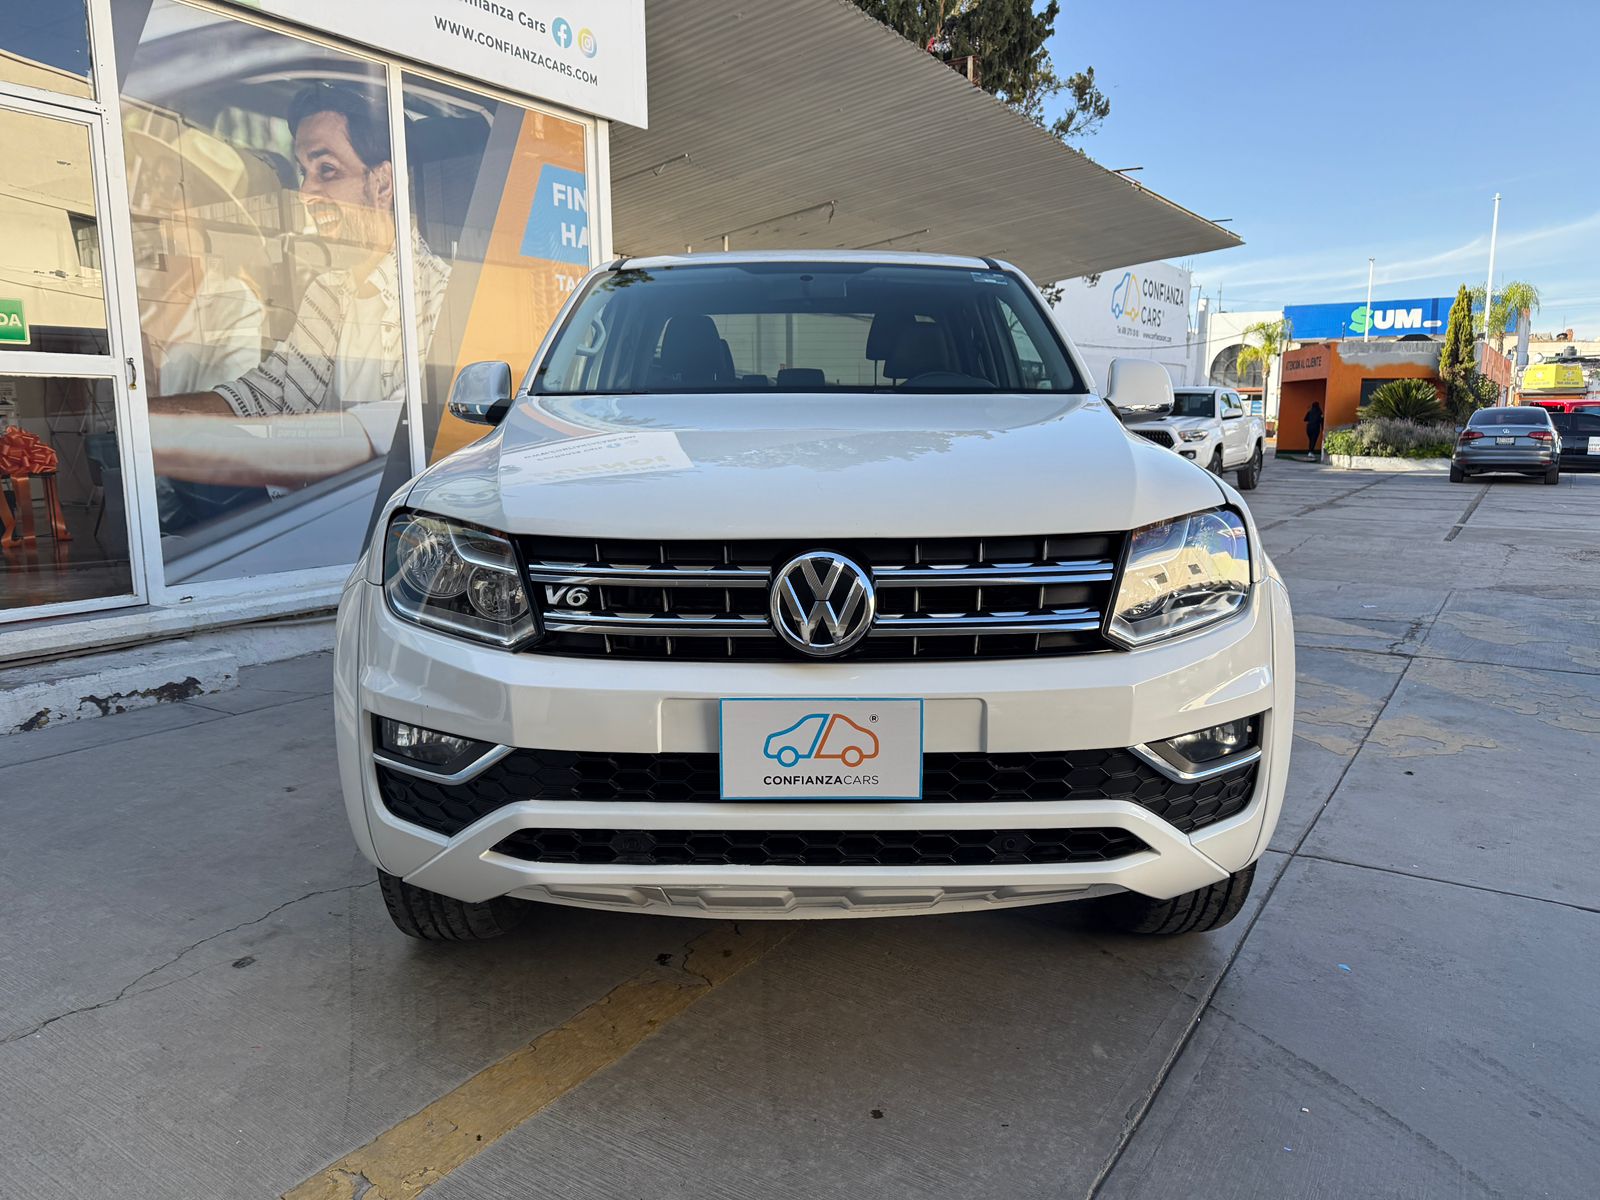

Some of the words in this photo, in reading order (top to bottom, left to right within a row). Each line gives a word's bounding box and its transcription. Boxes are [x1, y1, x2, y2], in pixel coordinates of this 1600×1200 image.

[518, 11, 546, 34] Cars
[434, 15, 598, 87] WWW.CONFIANZACARS.COM
[1142, 278, 1184, 308] CONFIANZA
[1141, 306, 1161, 328] CARS
[544, 584, 590, 607] V6
[763, 774, 879, 786] CONFIANZACARS
